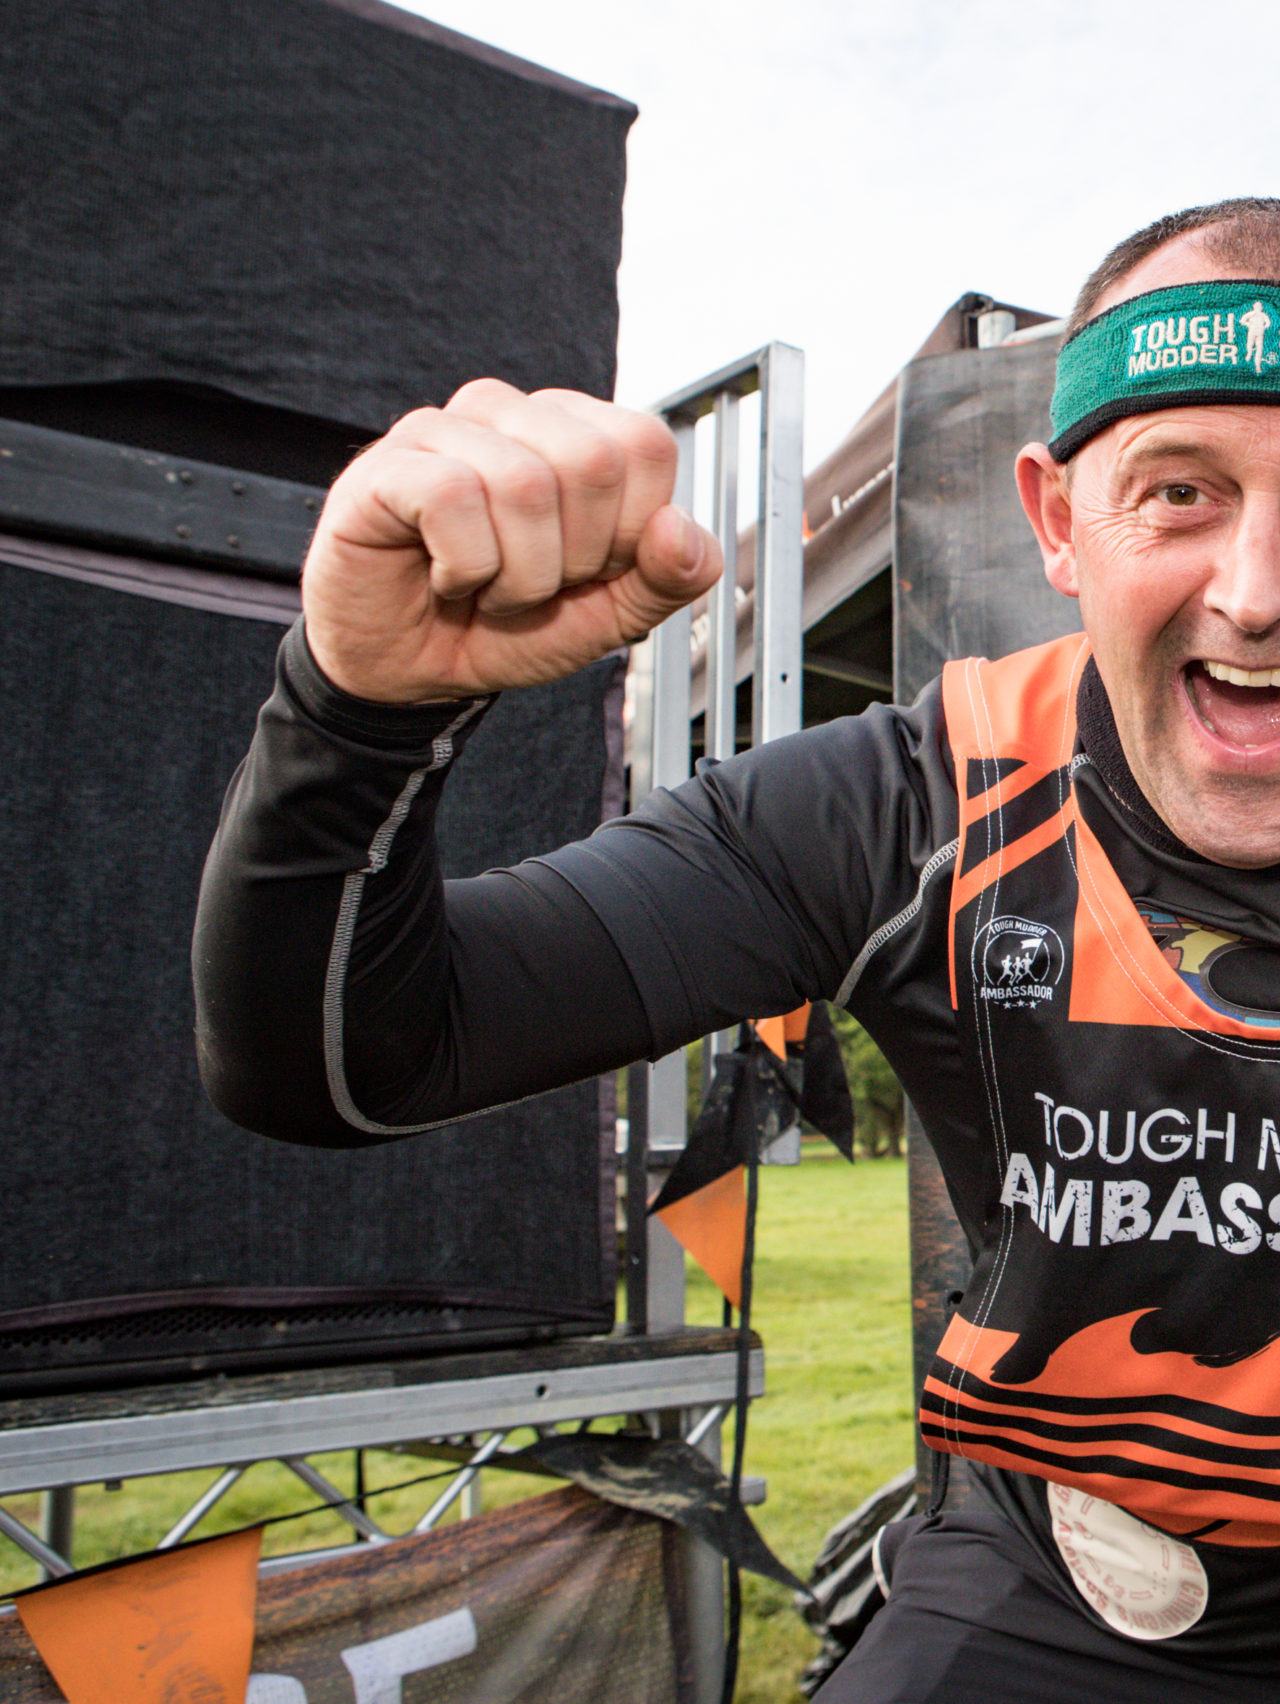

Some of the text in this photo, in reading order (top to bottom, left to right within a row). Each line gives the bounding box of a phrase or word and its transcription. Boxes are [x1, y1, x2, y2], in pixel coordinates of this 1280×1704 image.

[1131, 312, 1236, 349] TOUGH
[1127, 344, 1238, 377] MUDDER
[989, 919, 1048, 937] TOUGH MUDDER
[980, 984, 1053, 1001] AMBASSADOR
[1034, 1092, 1236, 1165] TOUGH
